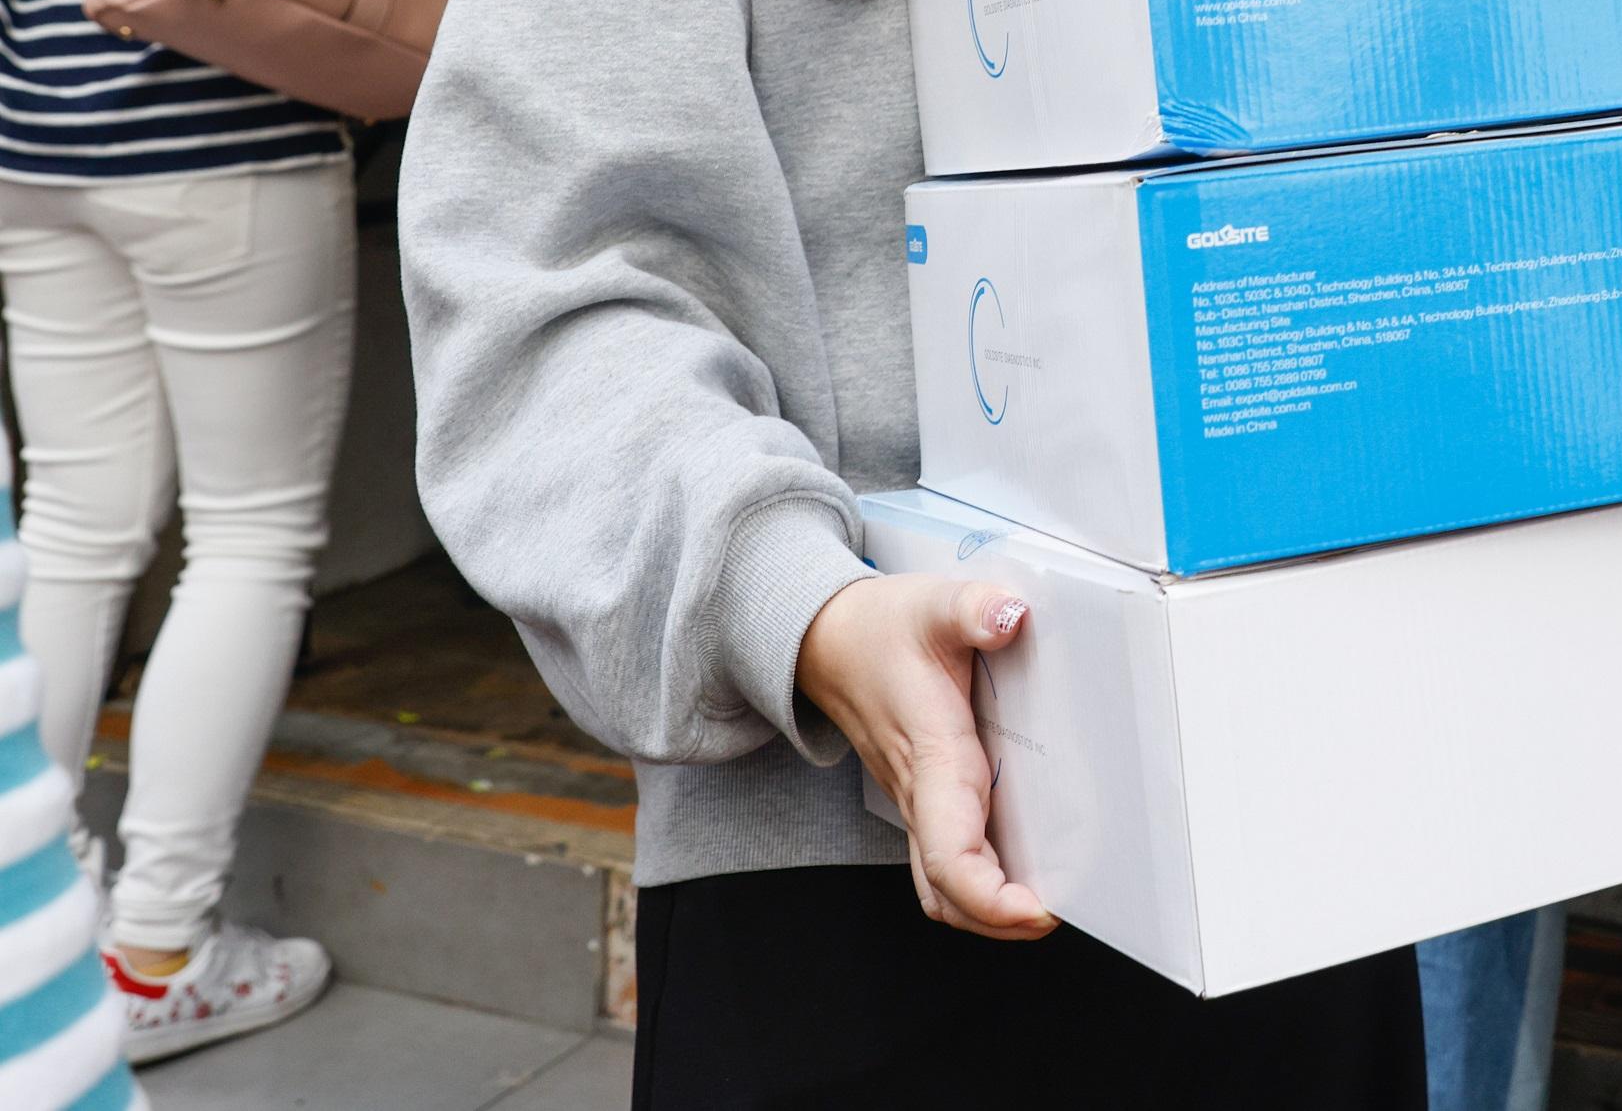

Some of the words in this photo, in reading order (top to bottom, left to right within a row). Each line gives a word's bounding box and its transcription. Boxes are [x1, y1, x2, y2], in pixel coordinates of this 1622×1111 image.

[1192, 280, 1235, 292] Address
[1236, 277, 1248, 287] of
[1249, 271, 1317, 286] Manufacturer
[1193, 297, 1212, 307] No.
[1245, 288, 1272, 301] 503C
[1274, 287, 1283, 298] &
[1316, 279, 1373, 293] Technology
[1374, 273, 1413, 287] Building
[1415, 271, 1422, 283] &
[1424, 270, 1441, 282] No.
[1443, 267, 1456, 280] 3A
[1458, 266, 1466, 278] &
[1467, 264, 1484, 277] 4A,
[1485, 259, 1540, 275] Technology
[1541, 254, 1577, 269] Building
[1578, 252, 1610, 264] Annex,
[1195, 304, 1260, 322] Sub-District,
[1262, 301, 1308, 314] Nanshan
[1310, 294, 1348, 308] District,
[1349, 290, 1401, 304] Shenzhen,
[1402, 286, 1434, 298] China,
[1435, 280, 1470, 294] 518067
[1196, 319, 1269, 337] Manufacturing
[1271, 316, 1292, 328] Site
[1197, 339, 1216, 350] No.
[1218, 335, 1244, 348] 103C
[1246, 330, 1304, 345] Technology
[1306, 323, 1345, 337] Building
[1347, 321, 1355, 332] &
[1357, 320, 1374, 331] No.
[1376, 317, 1390, 329] 3A
[1392, 316, 1399, 327] &
[1401, 314, 1418, 327] 4A,
[1419, 309, 1474, 324] Technology
[1476, 303, 1513, 316] Building
[1515, 301, 1548, 311] Annex,
[1549, 295, 1600, 308] Zhaoshang
[1198, 352, 1246, 365] Nanshan
[1247, 345, 1285, 360] District,
[1287, 340, 1341, 354] Shenzhen,
[1342, 336, 1374, 347] China,
[1376, 330, 1411, 344] 518067
[1200, 367, 1219, 379] Tel:
[1224, 363, 1250, 376] 0086
[1299, 355, 1325, 368] 0807
[1200, 382, 1224, 394] Fax:
[1225, 377, 1252, 391] 0086
[1301, 369, 1328, 383] 0799
[1202, 395, 1233, 409] Email:
[1203, 401, 1312, 424] www.goldsite.com.cn
[1204, 425, 1234, 438] Made
[1236, 423, 1246, 434] in
[1247, 421, 1278, 433] China
